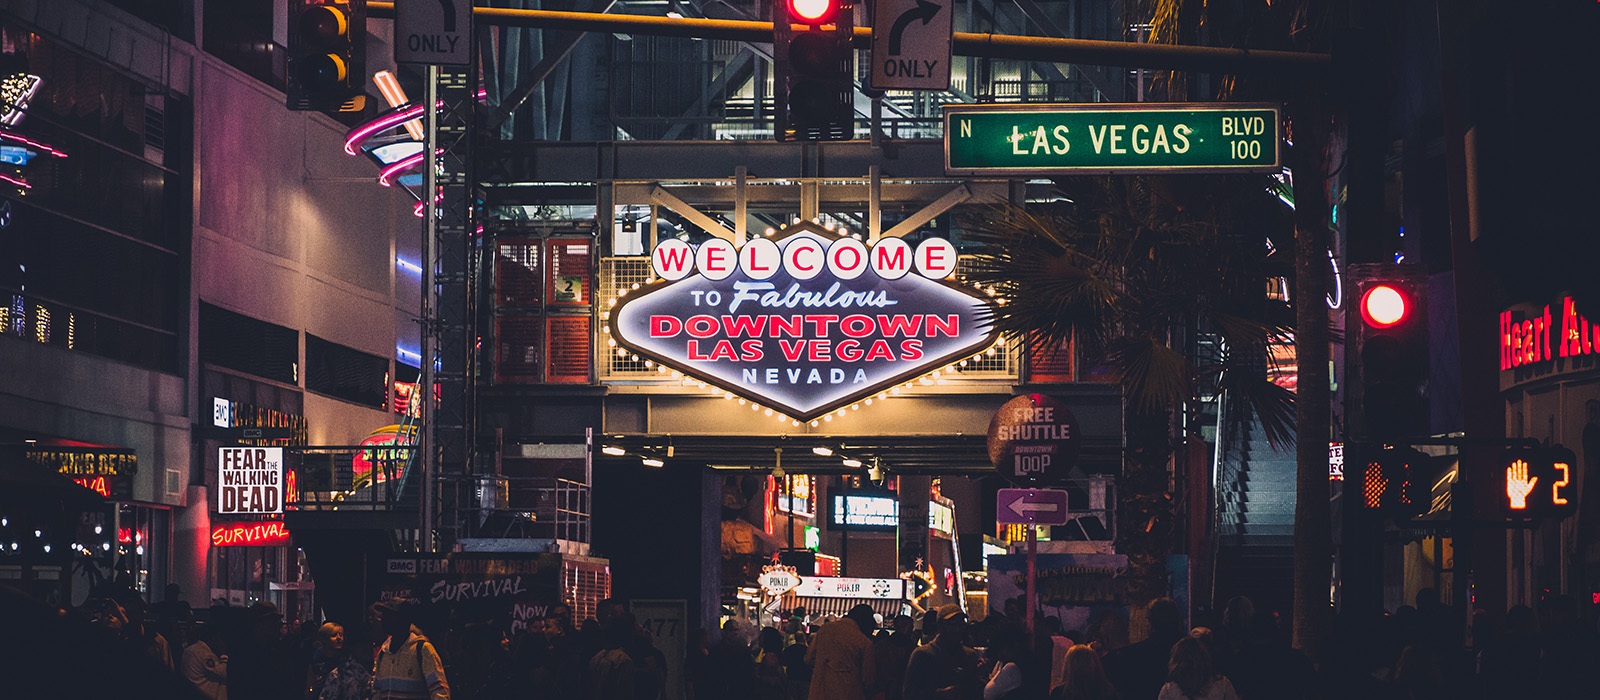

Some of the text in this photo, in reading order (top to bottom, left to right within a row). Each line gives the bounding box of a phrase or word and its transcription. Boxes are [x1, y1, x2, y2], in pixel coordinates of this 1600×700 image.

[407, 34, 459, 53] ONLY
[884, 59, 938, 79] ONLY
[960, 116, 1265, 155] N LAS VEGAS BLVD
[1230, 140, 1262, 160] 100
[658, 246, 946, 272] WELCOME
[565, 281, 573, 292] 2
[691, 281, 897, 314] TO Fabulous
[649, 315, 960, 338] DOWNTOWN
[1500, 304, 1552, 371] Heart
[687, 340, 925, 362] LAS VEGAS
[743, 367, 868, 383] NEVADA
[1013, 407, 1054, 423] FREE
[998, 424, 1070, 441] SHUTTLE
[1015, 445, 1053, 453] DOWNTOWN
[223, 449, 277, 470] FEAR THE
[1014, 454, 1051, 476] LOOP
[223, 471, 278, 486] WALKING
[1553, 463, 1569, 504] 2
[222, 486, 278, 513] DEAD
[212, 522, 289, 545] SURVIVAL
[420, 559, 449, 574] FEAR
[455, 559, 506, 574] WALKING
[509, 559, 538, 574] DEAD
[1062, 565, 1116, 577] Ultimat
[430, 576, 527, 603] SURVIVAL
[770, 578, 789, 587] POKER
[837, 584, 860, 593] POKER
